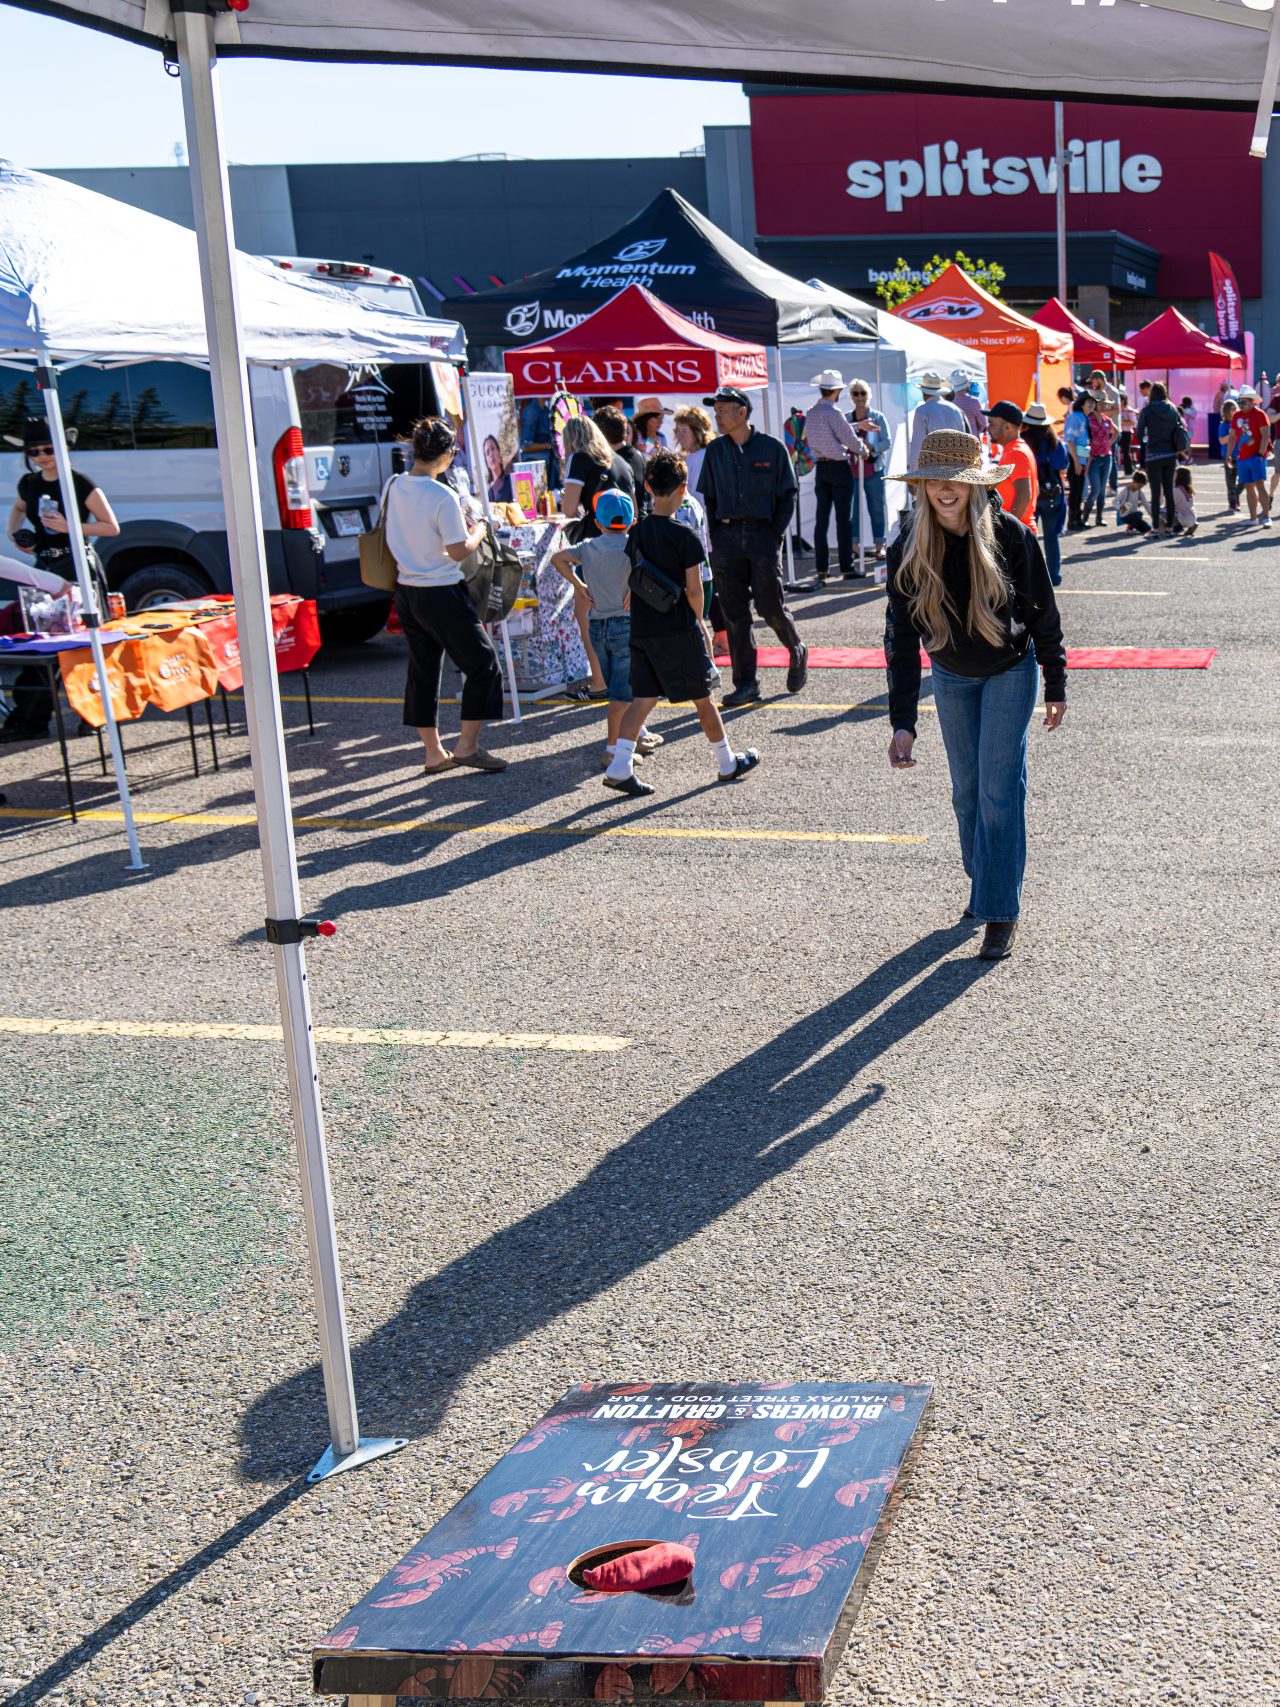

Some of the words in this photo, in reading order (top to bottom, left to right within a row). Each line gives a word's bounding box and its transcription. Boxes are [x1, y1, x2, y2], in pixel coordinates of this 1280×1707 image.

[845, 138, 1163, 212] splitsville
[556, 263, 697, 279] Momentum
[580, 275, 654, 289] Health
[908, 305, 978, 319] A&W
[1223, 278, 1239, 339] splitsville
[1217, 310, 1228, 340] bowl
[955, 336, 979, 347] hain
[522, 359, 702, 384] CLARINS
[720, 354, 766, 380] CLARINS
[808, 1395, 888, 1403] HALIFAX
[592, 1403, 730, 1419] GRAFTON
[752, 1403, 884, 1419] BLOWERS
[582, 1436, 830, 1489] Lobster
[576, 1482, 778, 1521] Team
